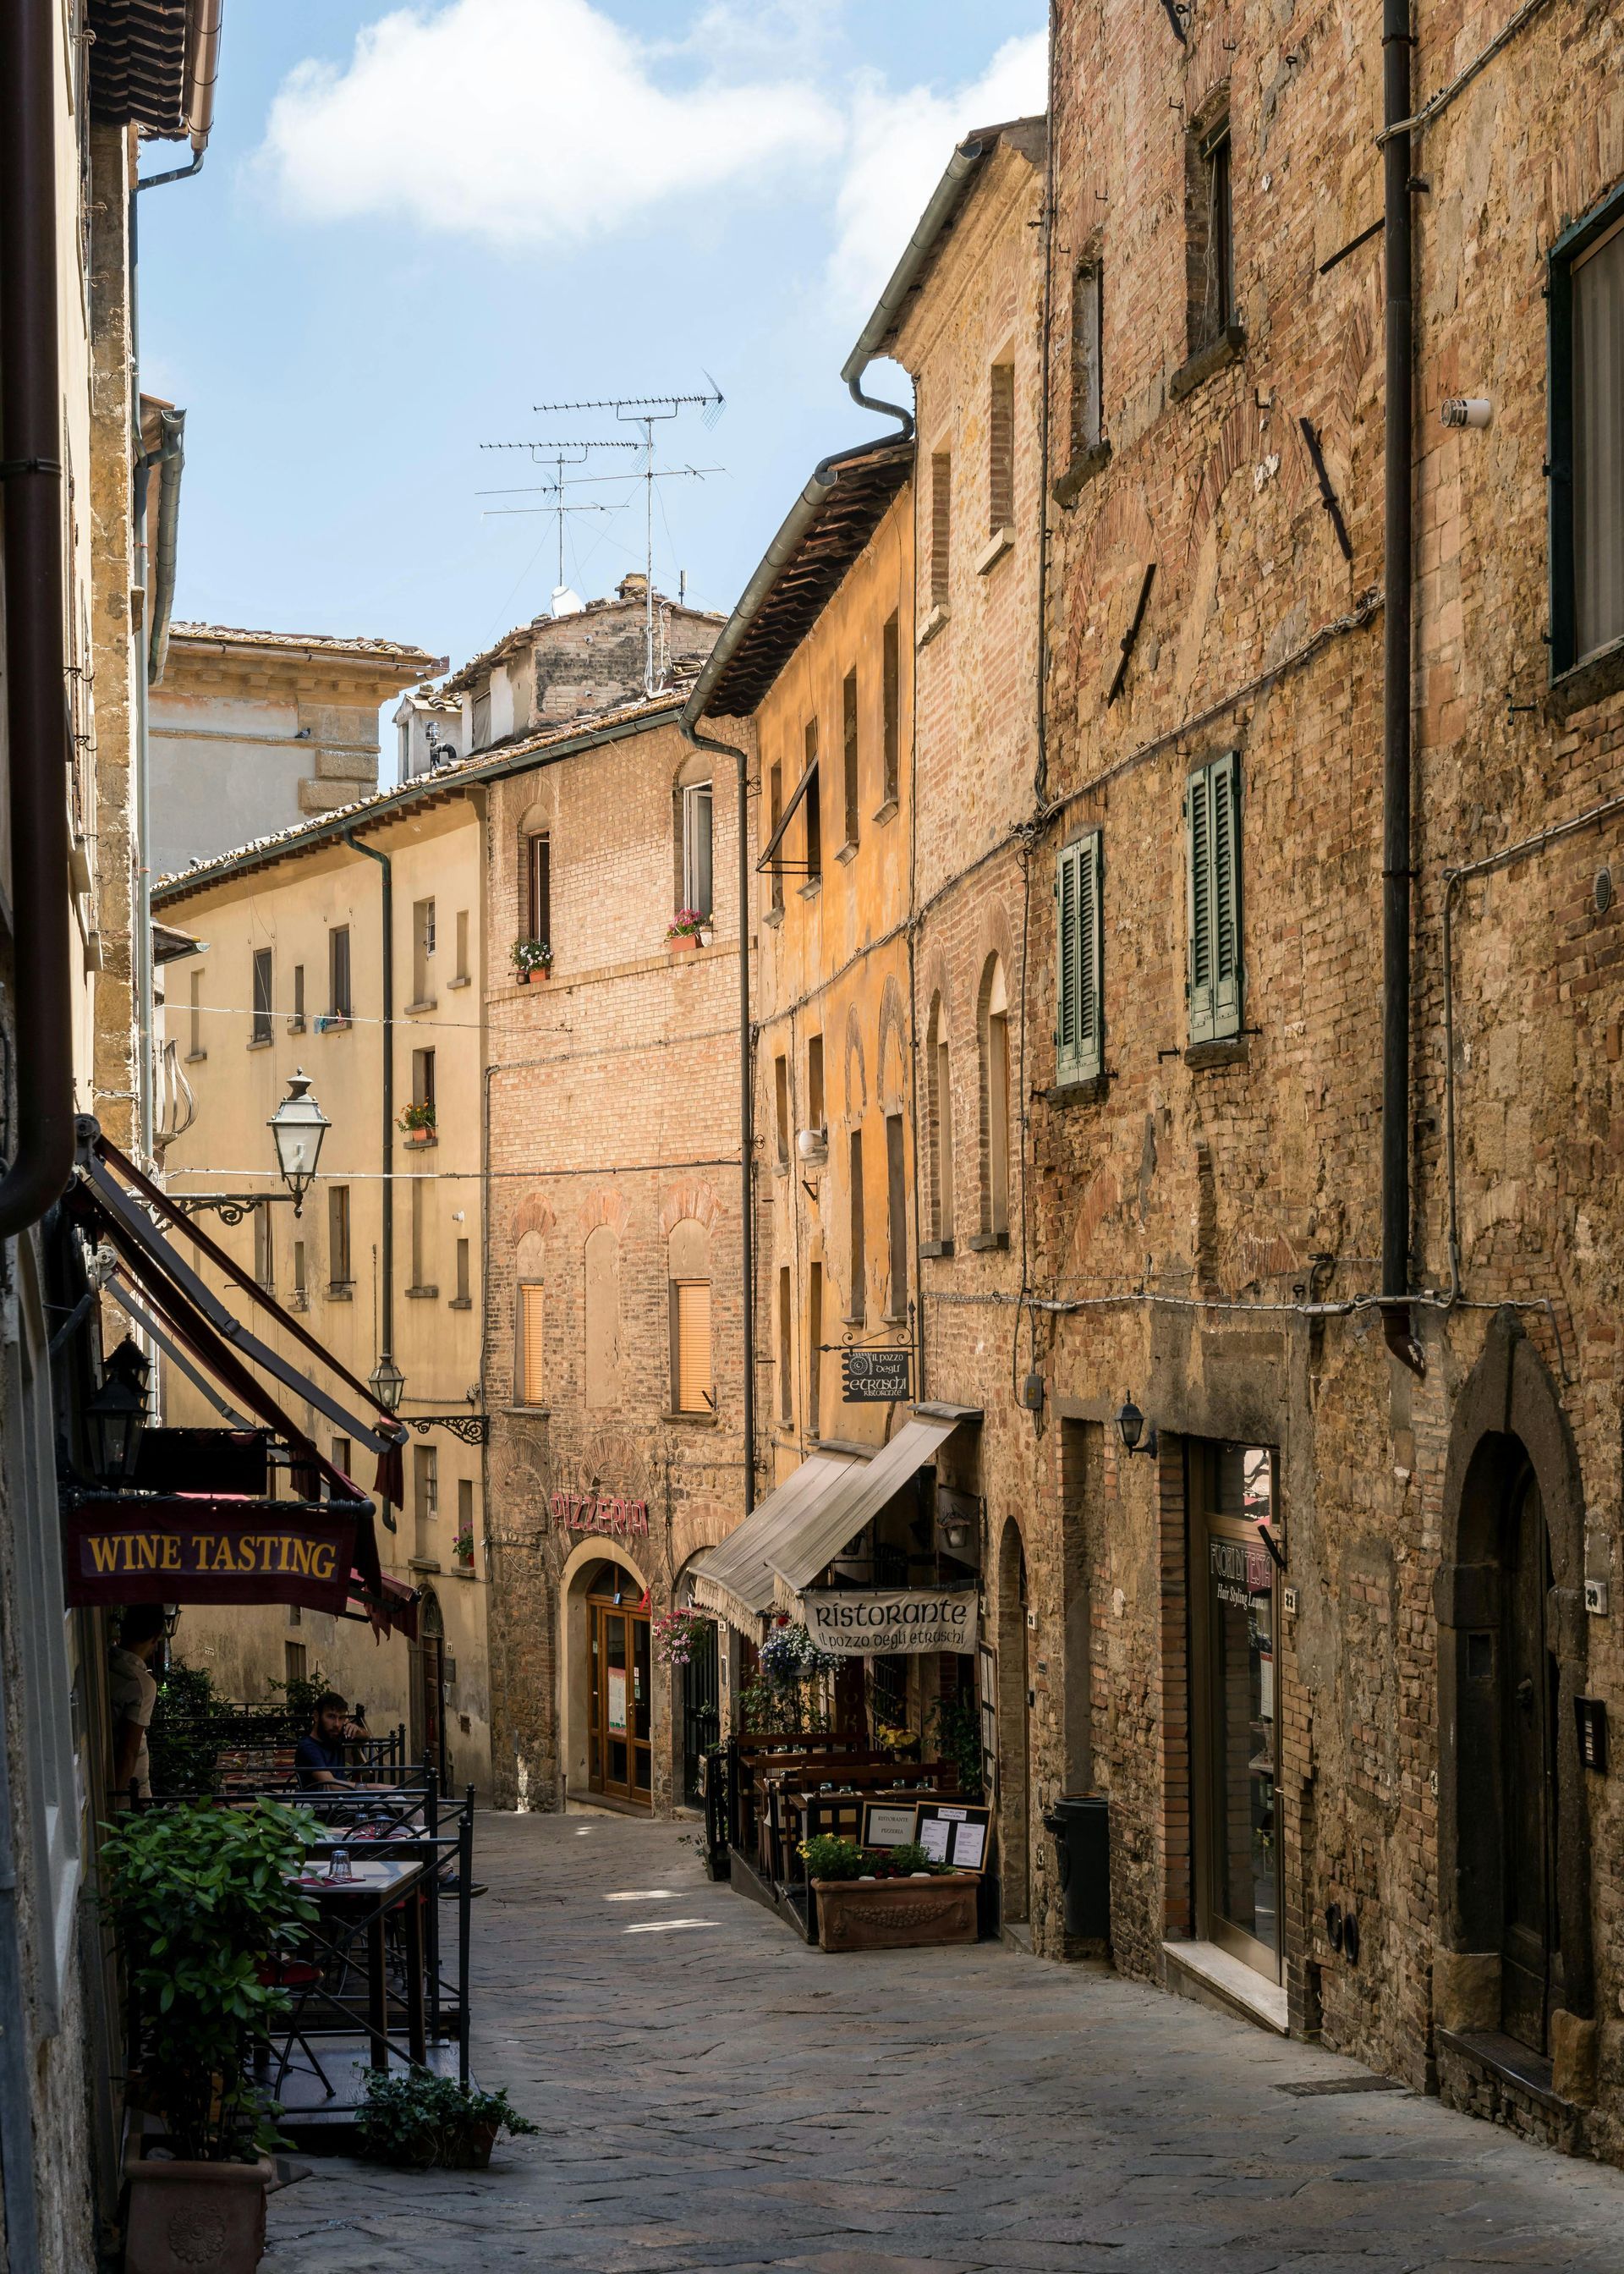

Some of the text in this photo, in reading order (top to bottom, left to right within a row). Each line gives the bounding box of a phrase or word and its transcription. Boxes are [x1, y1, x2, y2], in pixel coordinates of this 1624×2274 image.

[550, 1492, 649, 1538] PIZZERIA
[88, 1535, 337, 1579] WINE TASTING
[1217, 1583, 1230, 1600] Hair
[1229, 1586, 1248, 1611] Styling
[1285, 1593, 1293, 1608] 22
[819, 1629, 965, 1650] il pozzo degli etruschi
